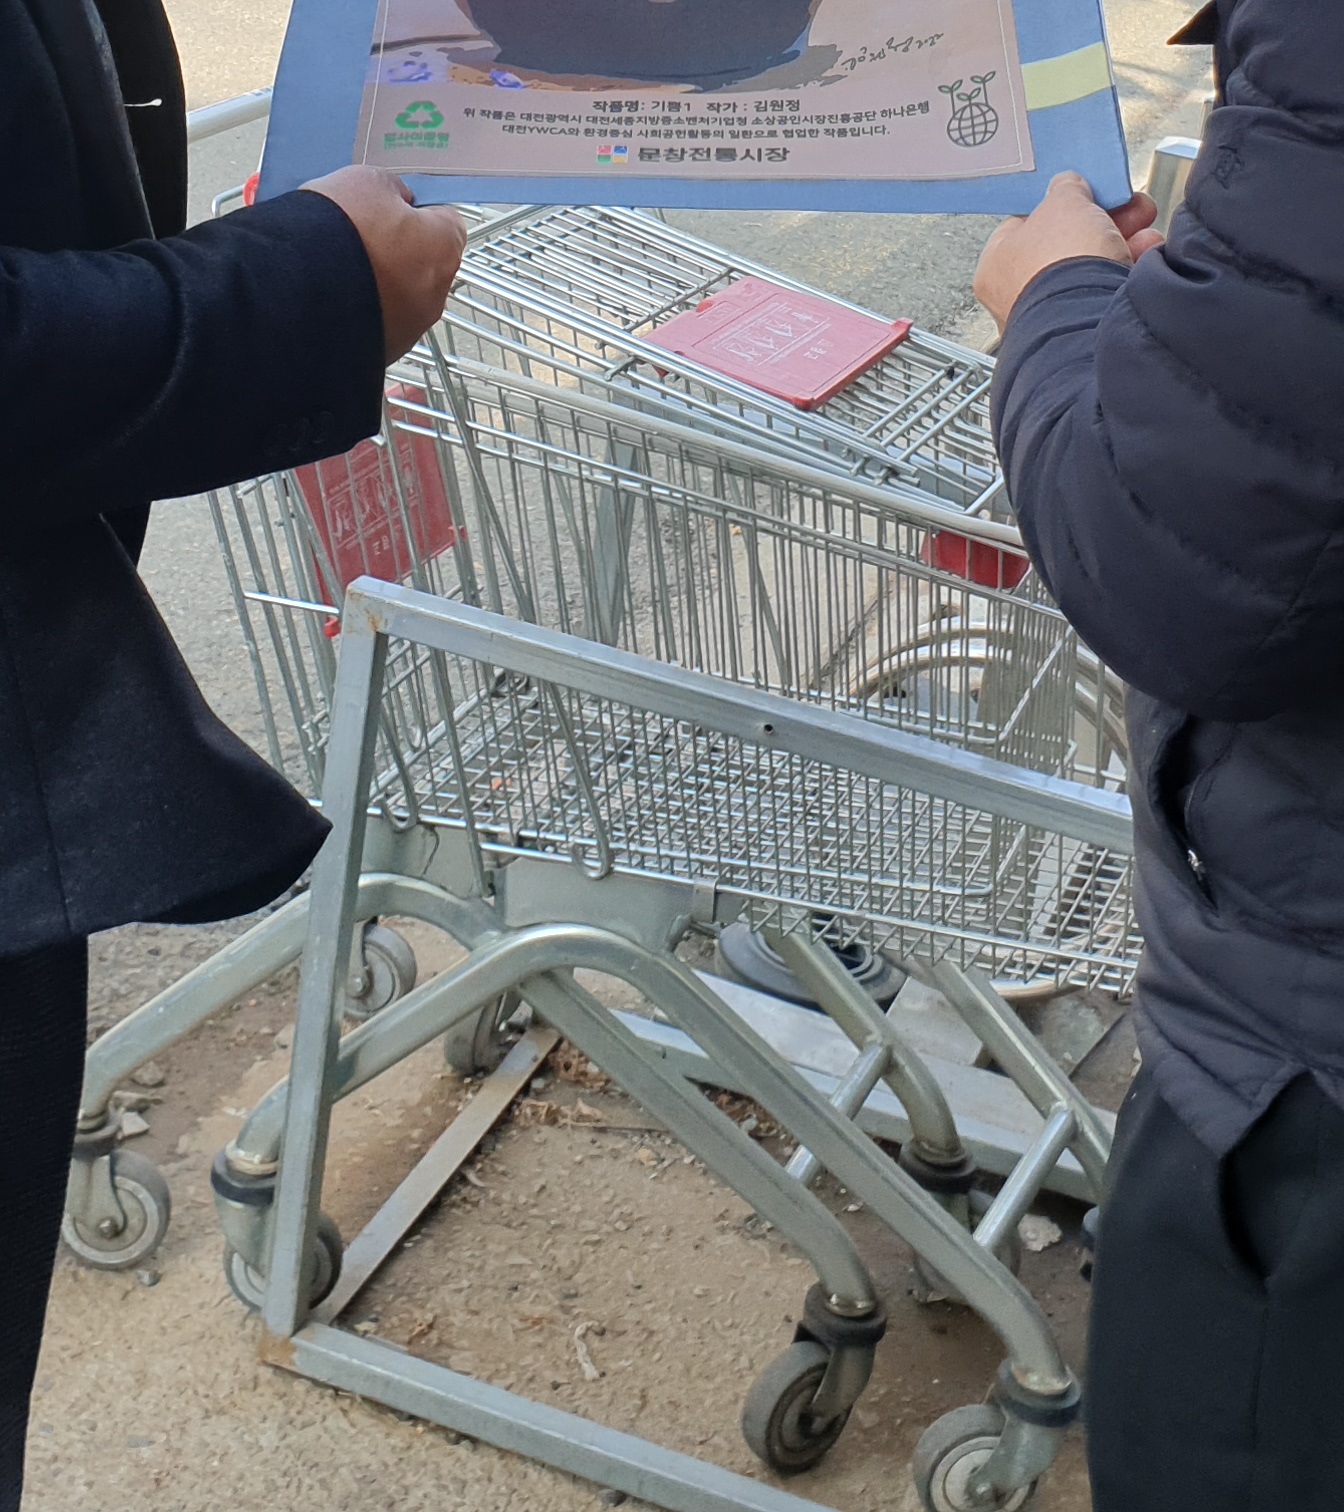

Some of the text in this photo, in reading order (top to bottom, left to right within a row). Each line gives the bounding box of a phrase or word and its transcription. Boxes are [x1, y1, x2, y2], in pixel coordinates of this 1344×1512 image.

[462, 107, 476, 118] 위
[479, 108, 517, 121] 작품은
[520, 112, 582, 125] 대전광역시
[880, 100, 931, 119] 하나은행
[706, 101, 738, 114] 작가
[753, 99, 801, 113] 김원정
[501, 123, 580, 137] 대전YWCA와
[582, 126, 633, 139] 환경중심
[782, 127, 820, 139] 협업한
[822, 125, 891, 139] 작품입니다.
[637, 147, 791, 163] 문창전통시장
